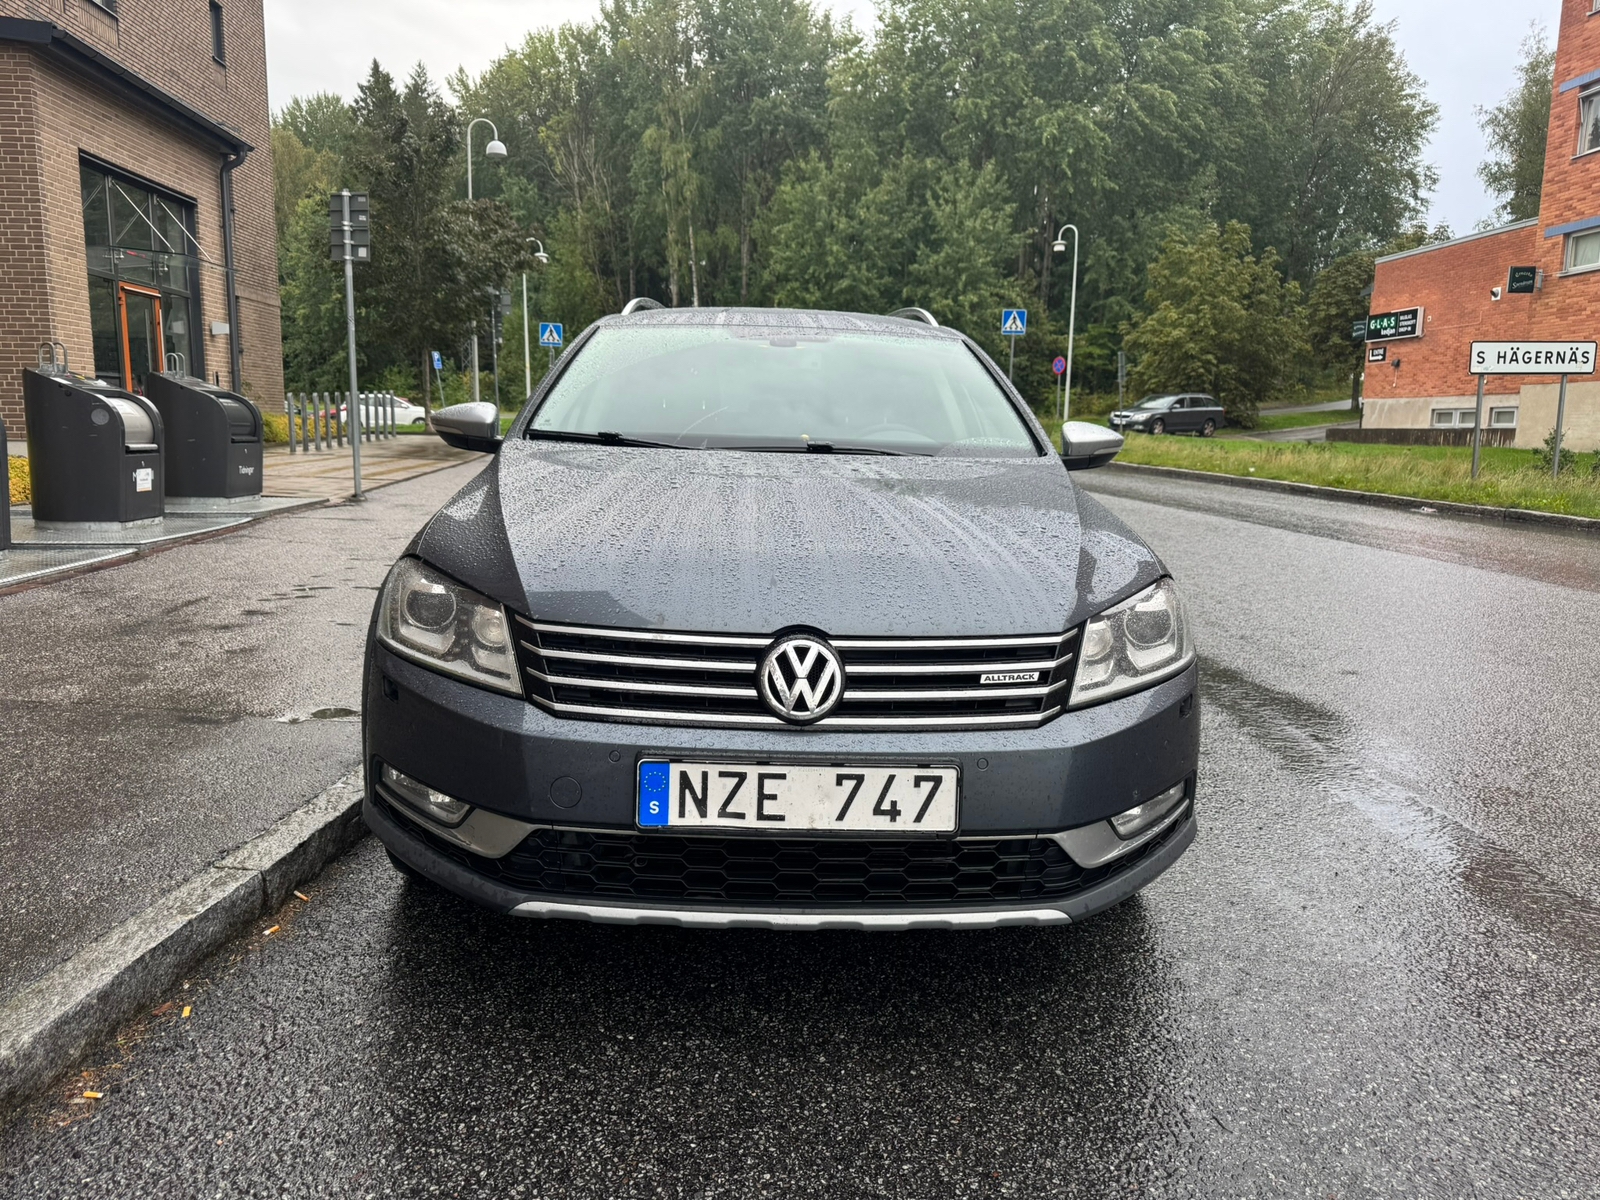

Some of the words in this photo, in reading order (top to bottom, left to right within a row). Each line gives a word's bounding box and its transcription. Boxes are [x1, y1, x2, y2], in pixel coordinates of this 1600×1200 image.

[1476, 351, 1486, 364] S
[1496, 347, 1590, 364] HÄGERNÄS
[761, 638, 842, 719] VW
[984, 673, 1035, 682] ALLTRACK
[649, 800, 660, 814] S
[678, 770, 787, 821] NZE
[835, 773, 943, 823] 747
